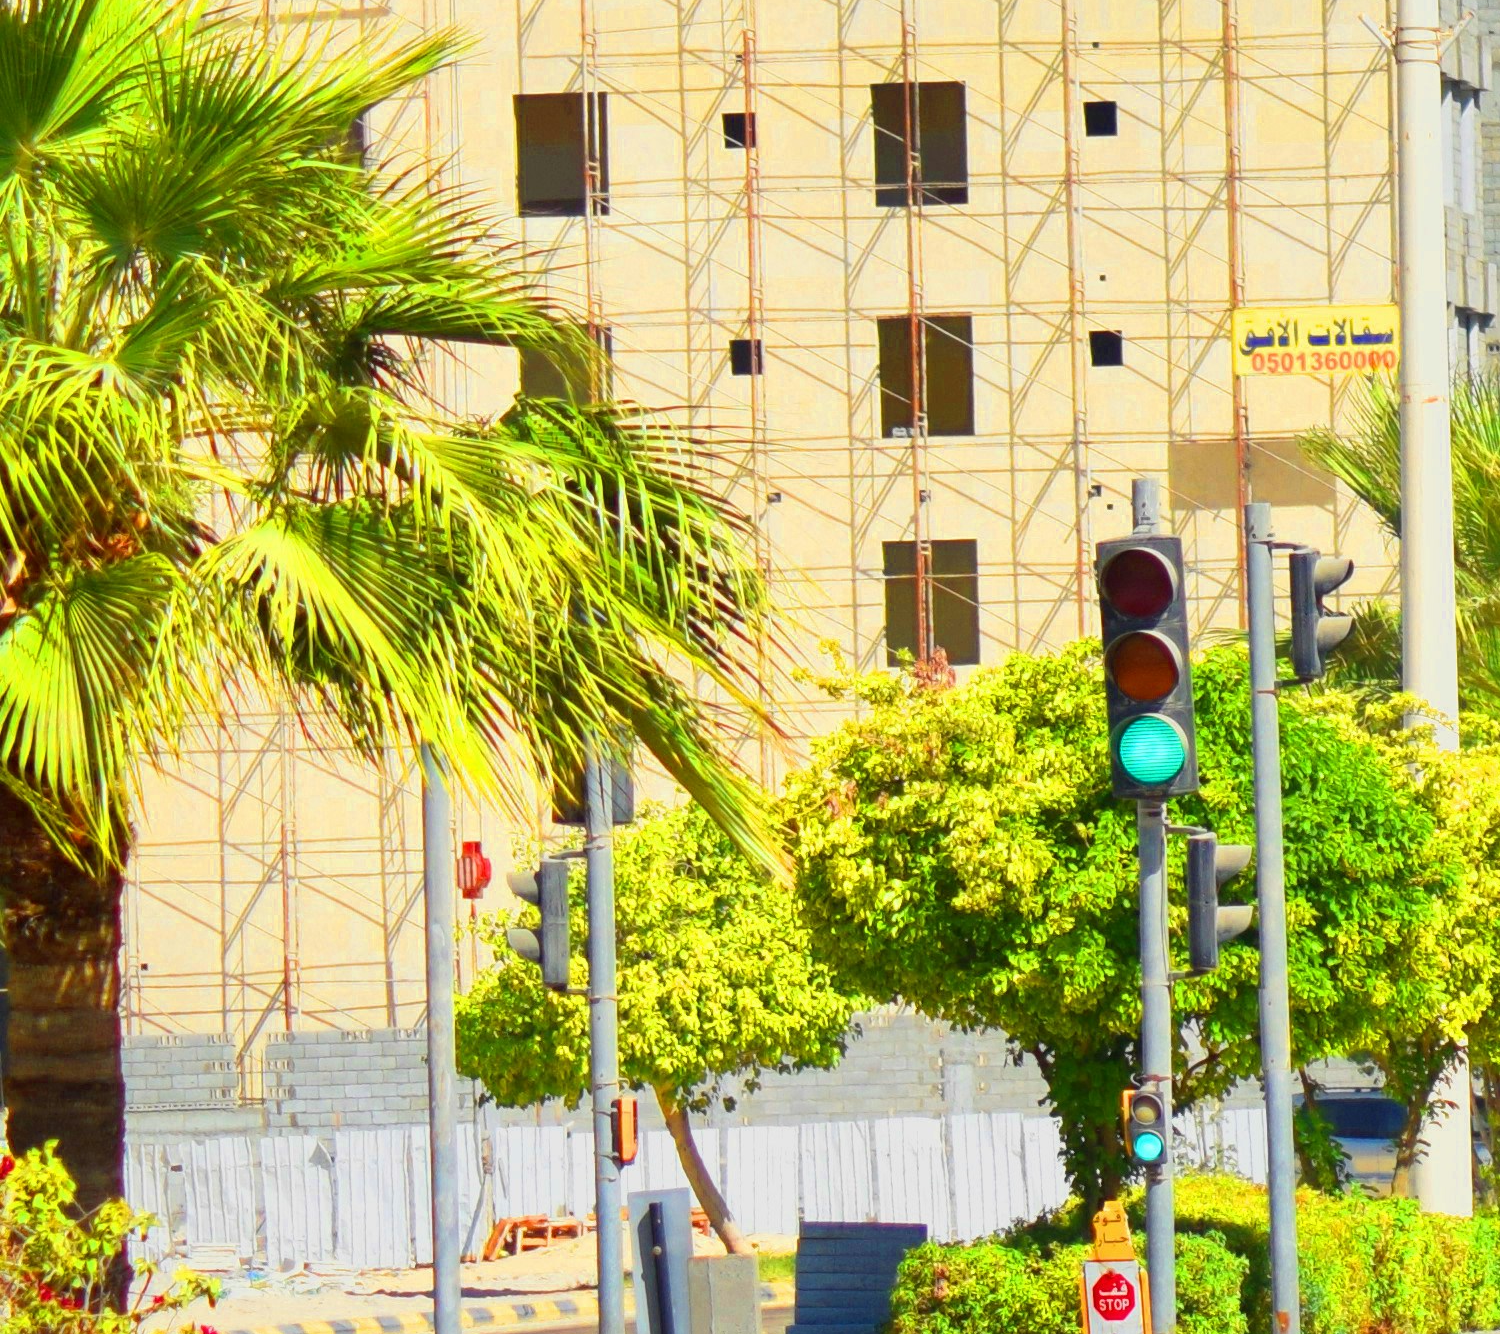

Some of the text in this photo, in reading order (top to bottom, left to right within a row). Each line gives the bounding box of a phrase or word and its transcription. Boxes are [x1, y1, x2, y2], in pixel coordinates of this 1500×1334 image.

[1308, 317, 1393, 347] سقالات
[1251, 350, 1397, 373] 0501360000
[1099, 1280, 1128, 1296] قف
[1099, 1298, 1130, 1311] STOP
